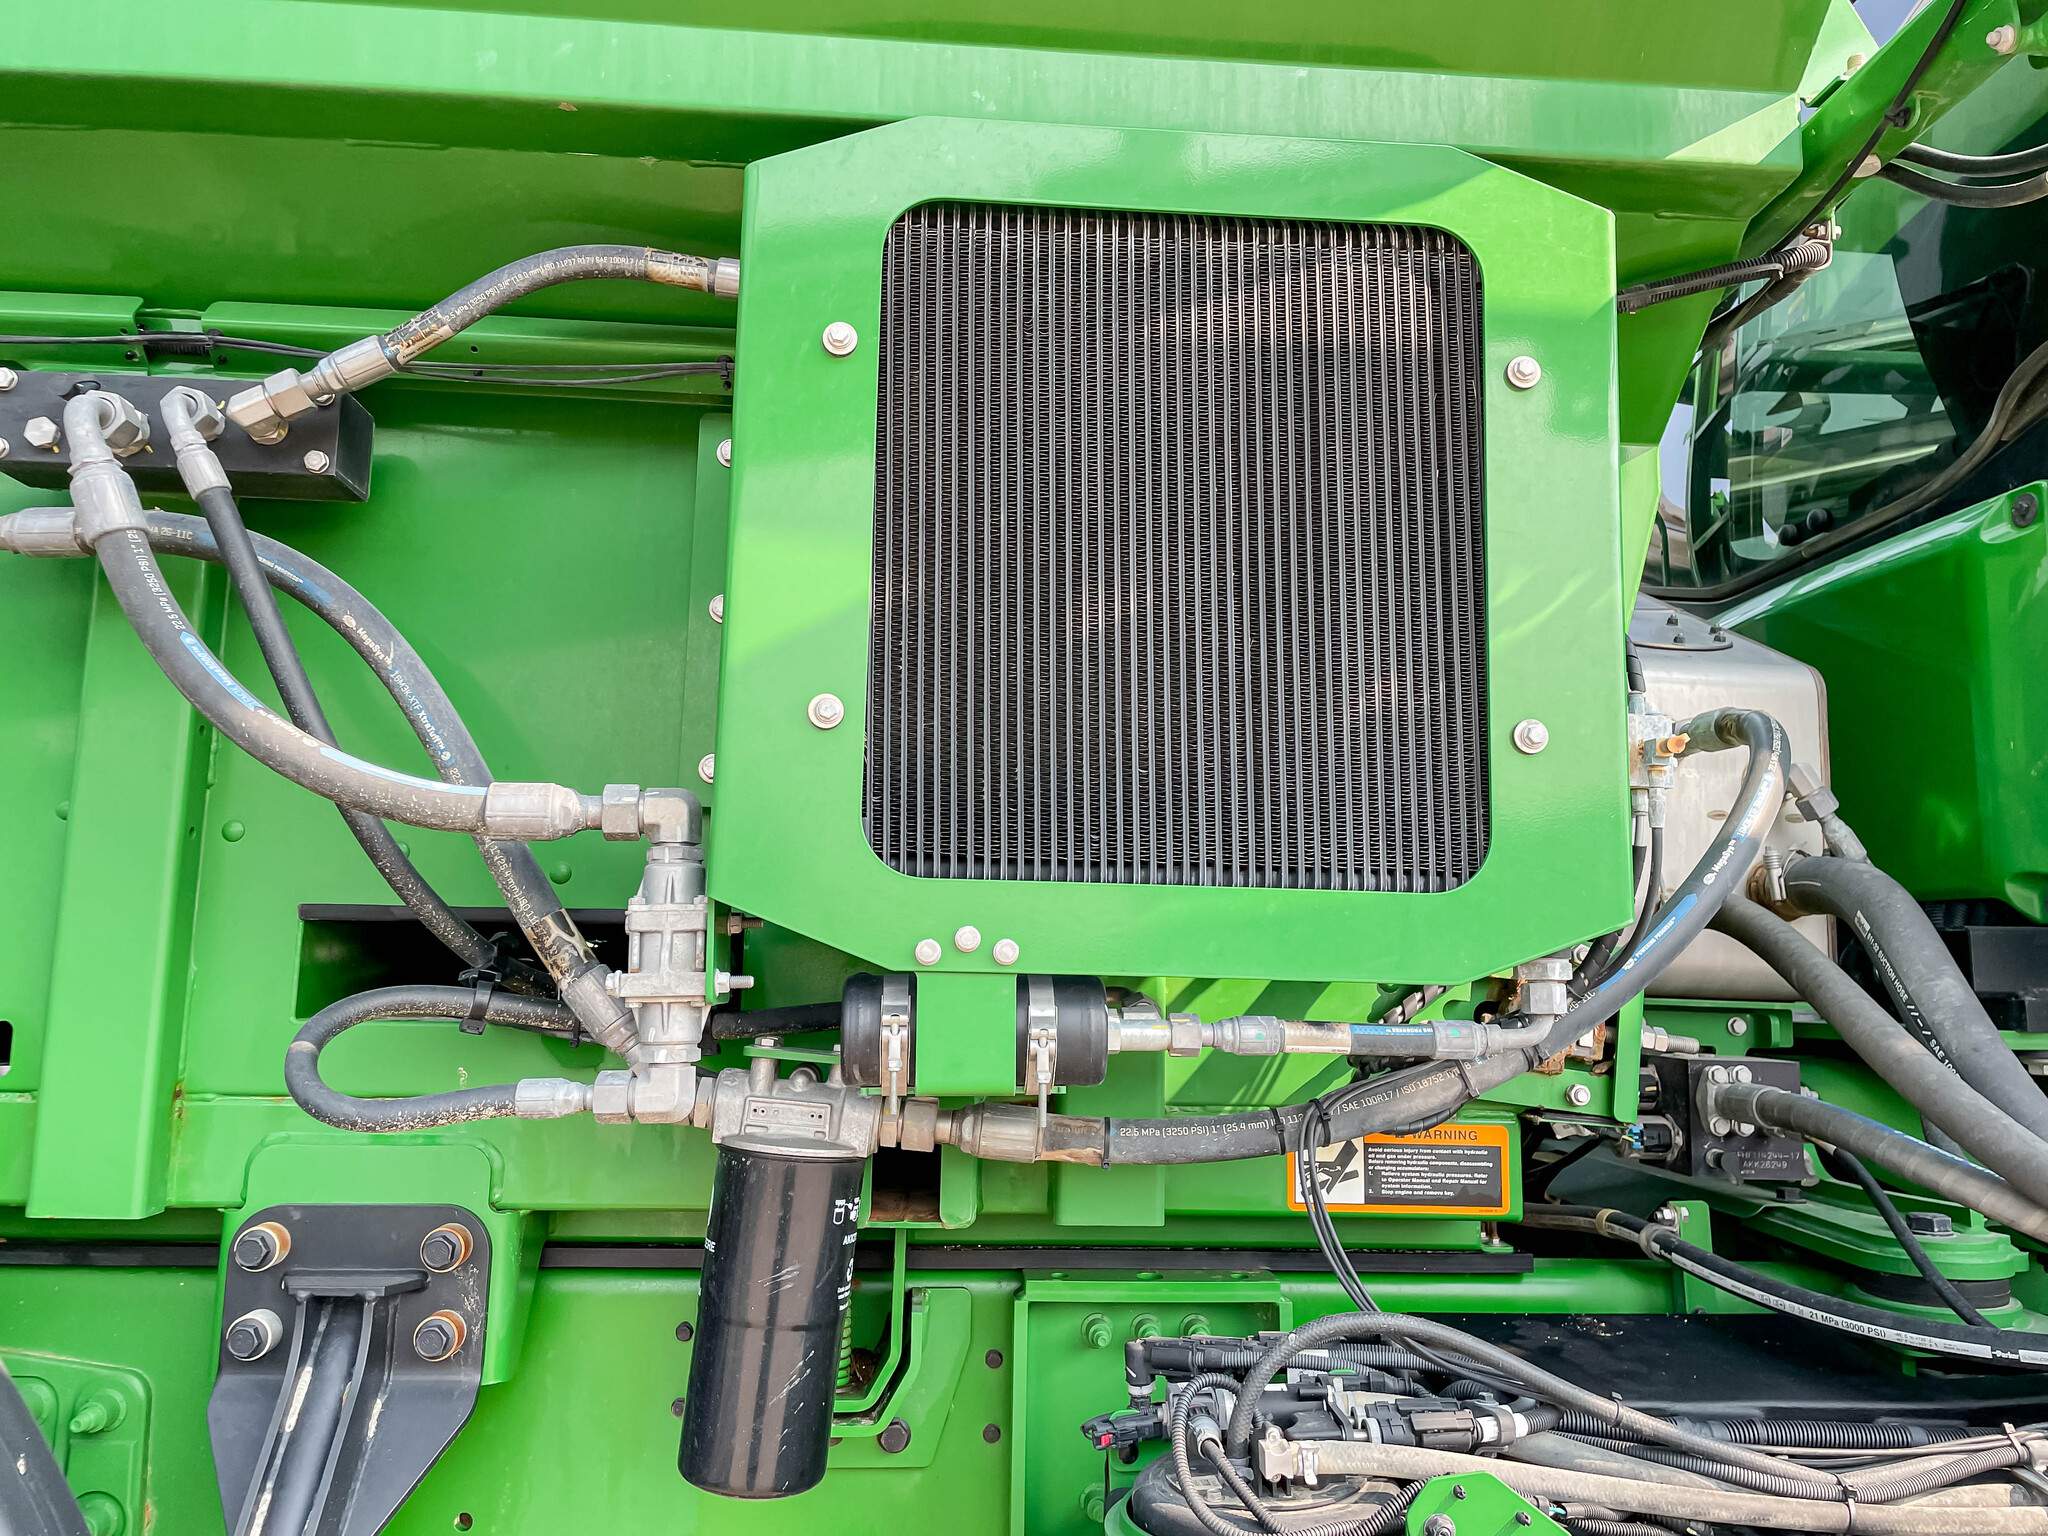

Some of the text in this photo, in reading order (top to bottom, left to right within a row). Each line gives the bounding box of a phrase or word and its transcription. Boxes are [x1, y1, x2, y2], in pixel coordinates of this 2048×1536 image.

[454, 303, 469, 316] MPa
[390, 670, 423, 711] 16M3K-XTF
[1877, 950, 1896, 980] SUCTION
[1894, 978, 1909, 1003] HOSE
[1929, 1039, 1946, 1060] SAE
[1120, 1127, 1140, 1137] 22.5
[1141, 1127, 1161, 1137] MPa
[1162, 1126, 1189, 1139] (3250
[1190, 1125, 1210, 1137] PSI)
[1222, 1120, 1247, 1135] (25.4
[1248, 1118, 1270, 1131] mm)
[1342, 1100, 1360, 1113] SAE
[1362, 1090, 1394, 1108] 100R17
[1401, 1082, 1416, 1095] ISO
[1417, 1073, 1445, 1089] 18752
[1412, 1129, 1478, 1141] WARNING
[1809, 1310, 1887, 1339] 21 MPa (3000 PSI)
